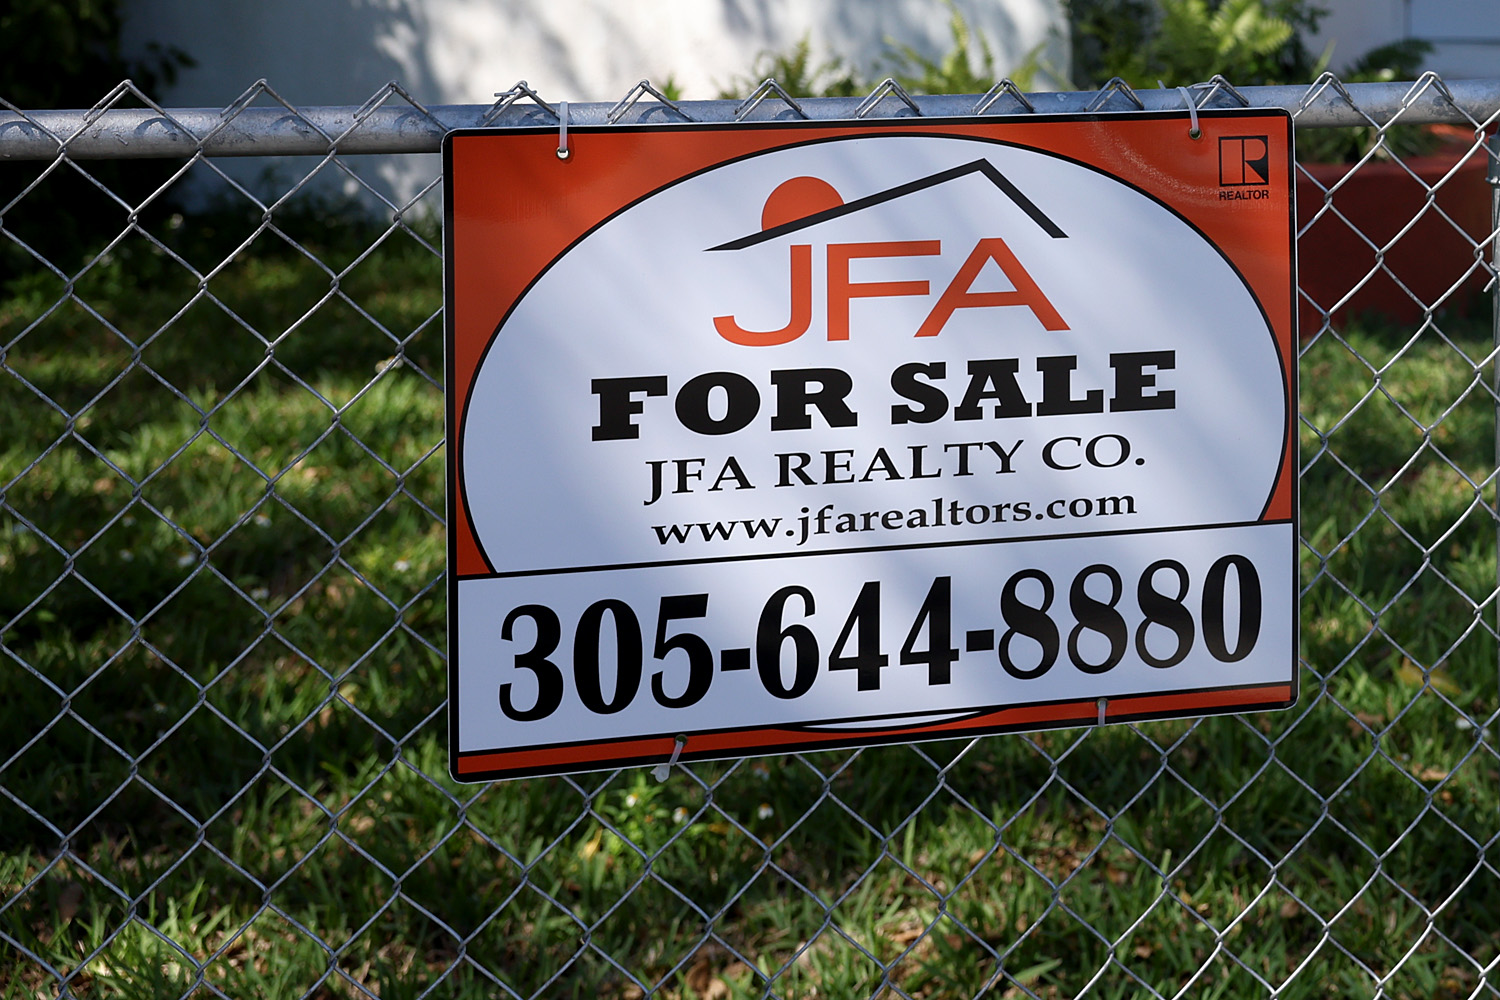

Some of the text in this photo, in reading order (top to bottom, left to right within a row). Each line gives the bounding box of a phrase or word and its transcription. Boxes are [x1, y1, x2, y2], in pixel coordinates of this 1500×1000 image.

[1218, 189, 1270, 201] REALTOR
[713, 237, 1071, 347] JFA
[591, 350, 1176, 442] FOR SALE
[643, 434, 1146, 506] JFA REALTY CO.
[651, 490, 1138, 546] www.jfarealtors.com
[498, 553, 1263, 722] 305-644-8880
